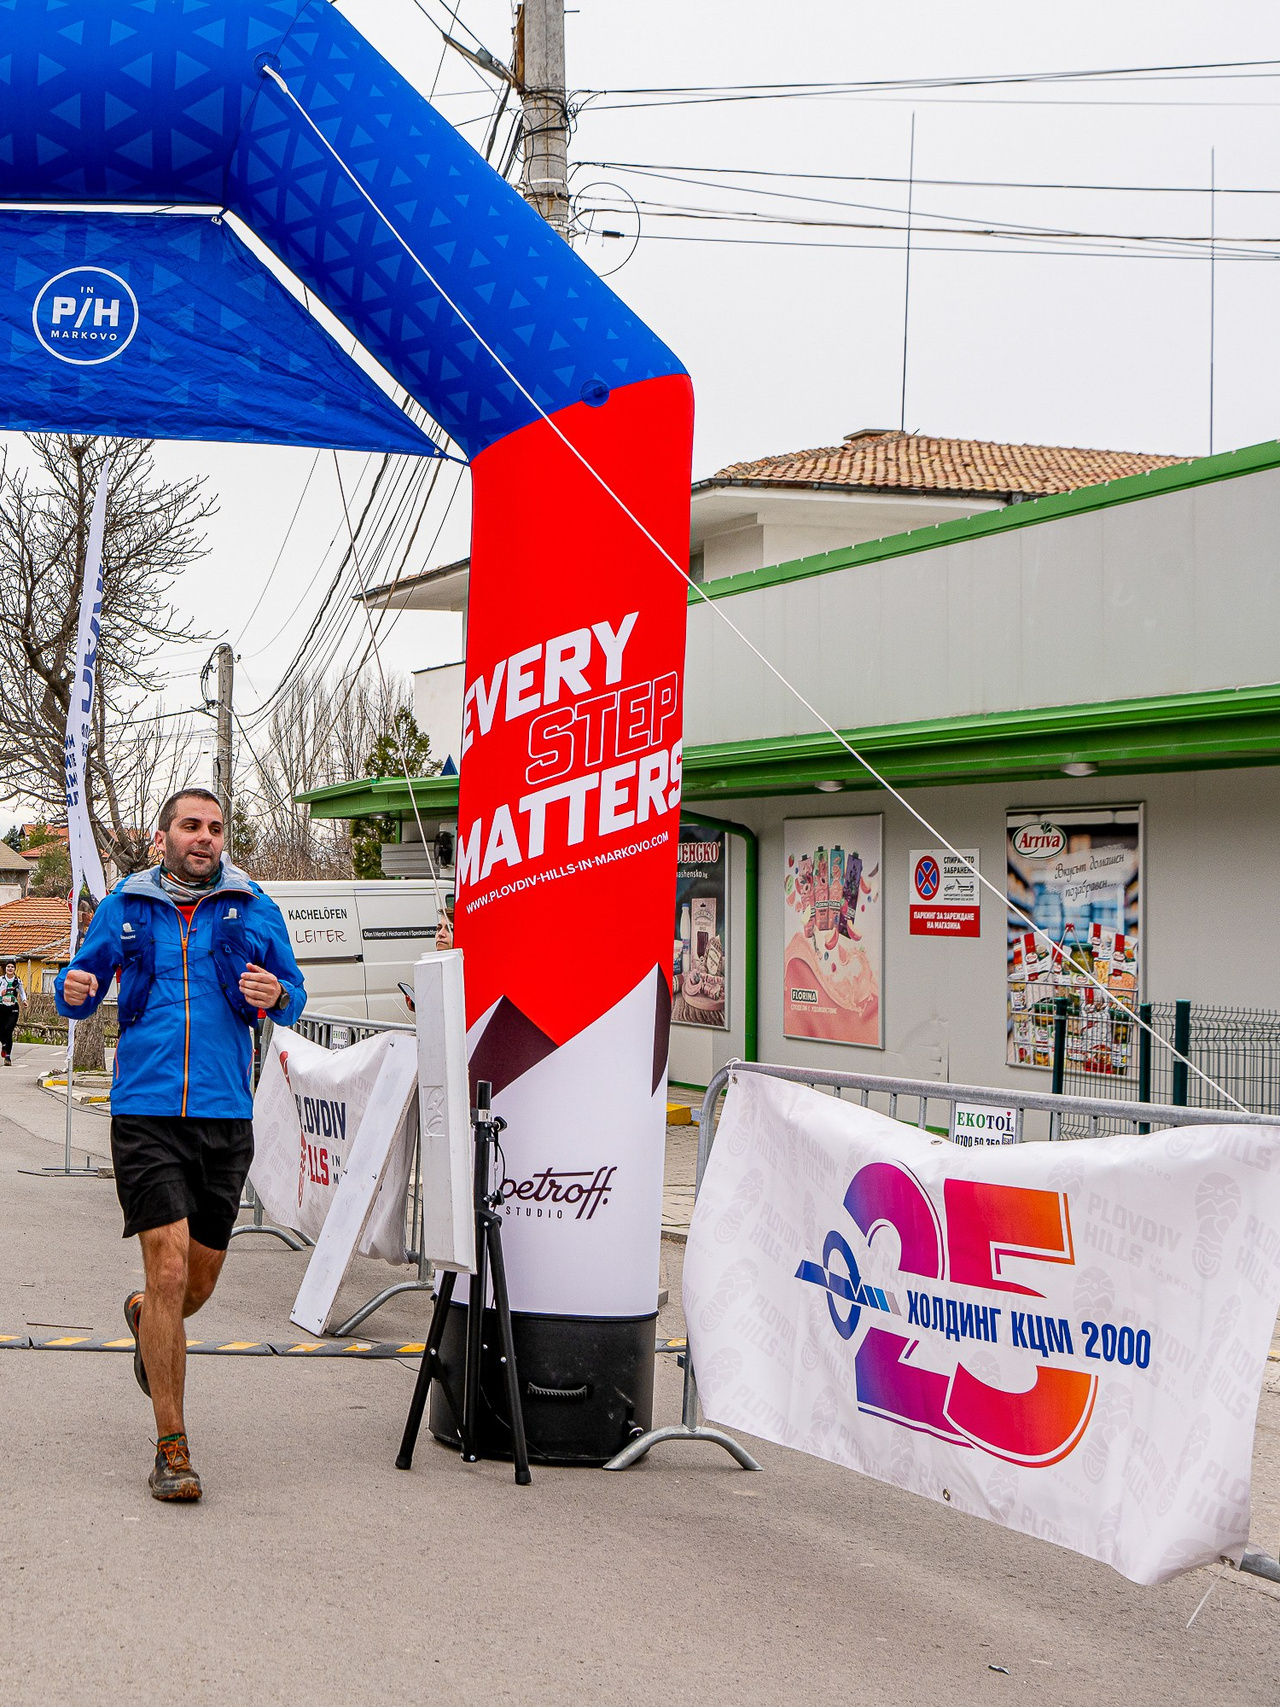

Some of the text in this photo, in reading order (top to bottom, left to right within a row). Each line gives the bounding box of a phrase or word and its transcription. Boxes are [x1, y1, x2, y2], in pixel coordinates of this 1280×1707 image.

[80, 286, 94, 294] IN
[51, 296, 120, 328] P/H
[50, 330, 118, 341] MARKOVO
[461, 610, 640, 761] EVERY
[525, 670, 679, 785] STEP
[455, 737, 683, 903] MATTERS
[1018, 832, 1061, 848] Arriva
[943, 855, 974, 865] СПИРАЕТО
[465, 830, 670, 915] WWW.PLOVDIV-HILLS-IN-MARKOVO.COM
[288, 907, 348, 920] KACHELÖFEN
[913, 911, 936, 919] ПАРКИНГ
[935, 921, 961, 929] МАГАЗИНА
[295, 929, 347, 943] LEITER
[792, 991, 816, 1001] FLORINA
[295, 1094, 346, 1140] OVDIV
[307, 1145, 330, 1186] LLS
[505, 1206, 563, 1219] STUDIO
[907, 1290, 1002, 1343] ХОЛДИНГ
[1011, 1311, 1074, 1358] КЦМ
[1082, 1321, 1151, 1369] 2000
